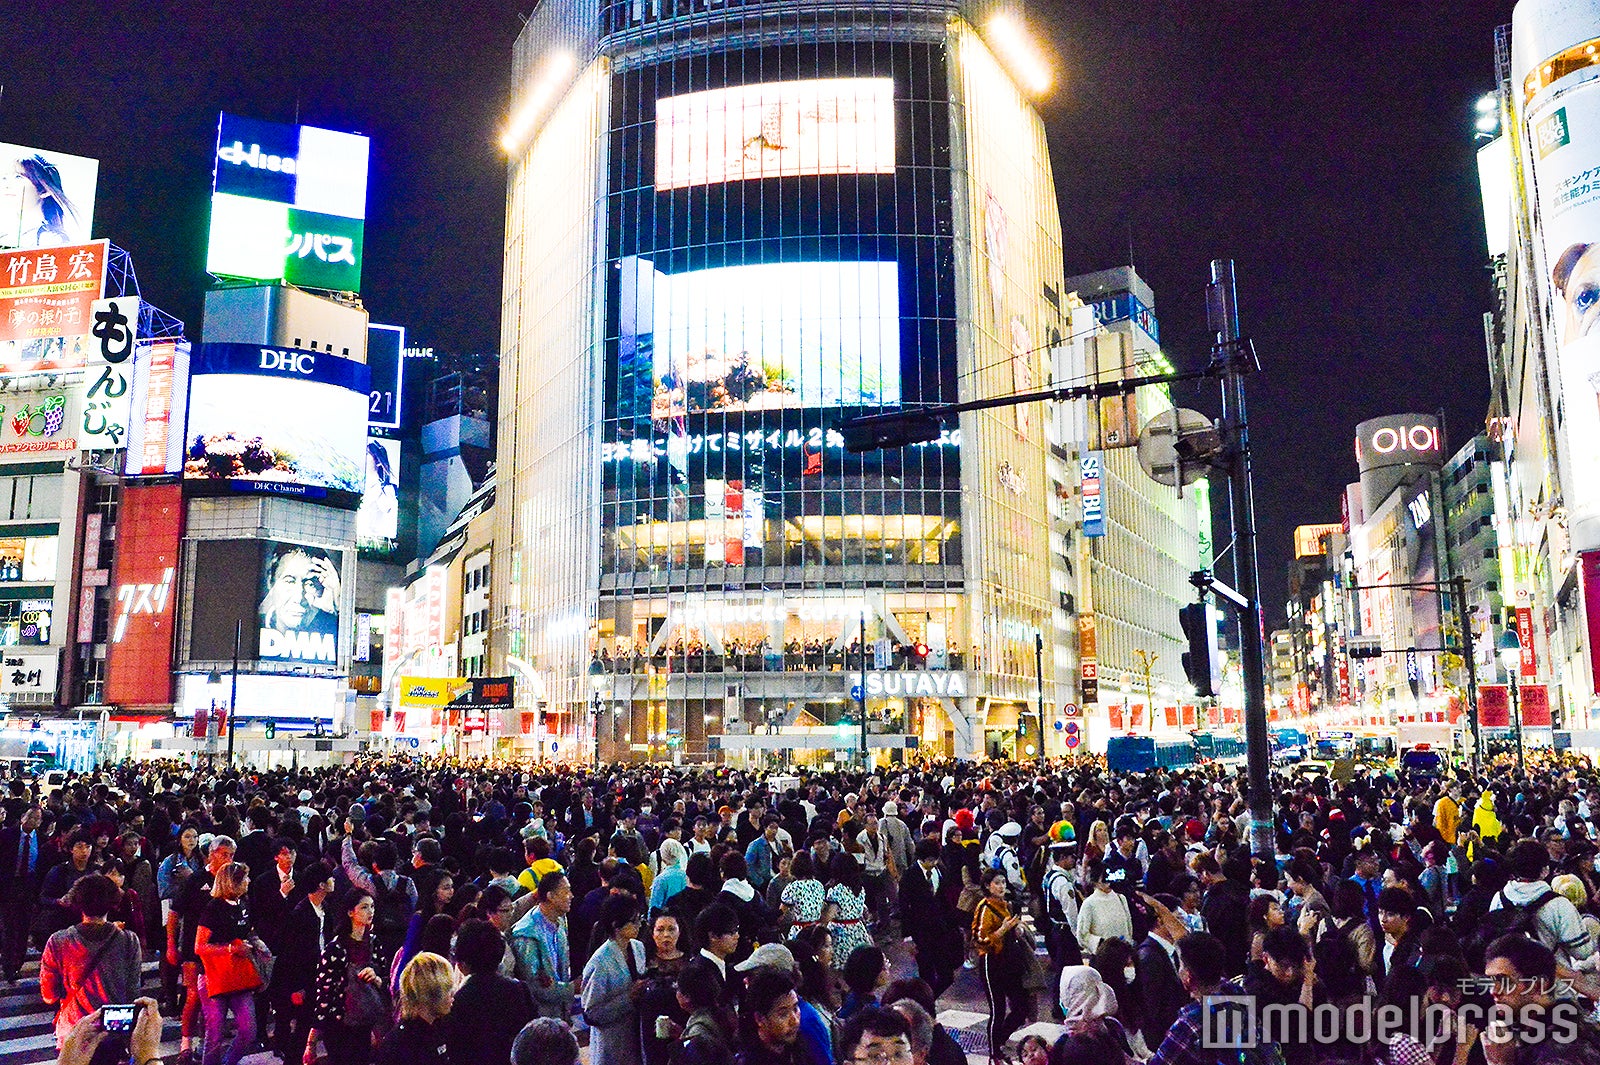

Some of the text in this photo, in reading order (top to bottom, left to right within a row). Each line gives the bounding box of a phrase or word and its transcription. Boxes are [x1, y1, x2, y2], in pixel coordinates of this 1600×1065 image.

[6, 249, 95, 286] 竹島 宏
[84, 302, 132, 445] もんじゃ
[260, 349, 314, 375] DHC
[369, 390, 392, 414] 21
[254, 482, 306, 493] DHC Channel
[1081, 456, 1101, 521] SEIBU
[112, 567, 175, 643] クスリ
[259, 628, 337, 661] DMM
[849, 672, 965, 695] TSUTAYA
